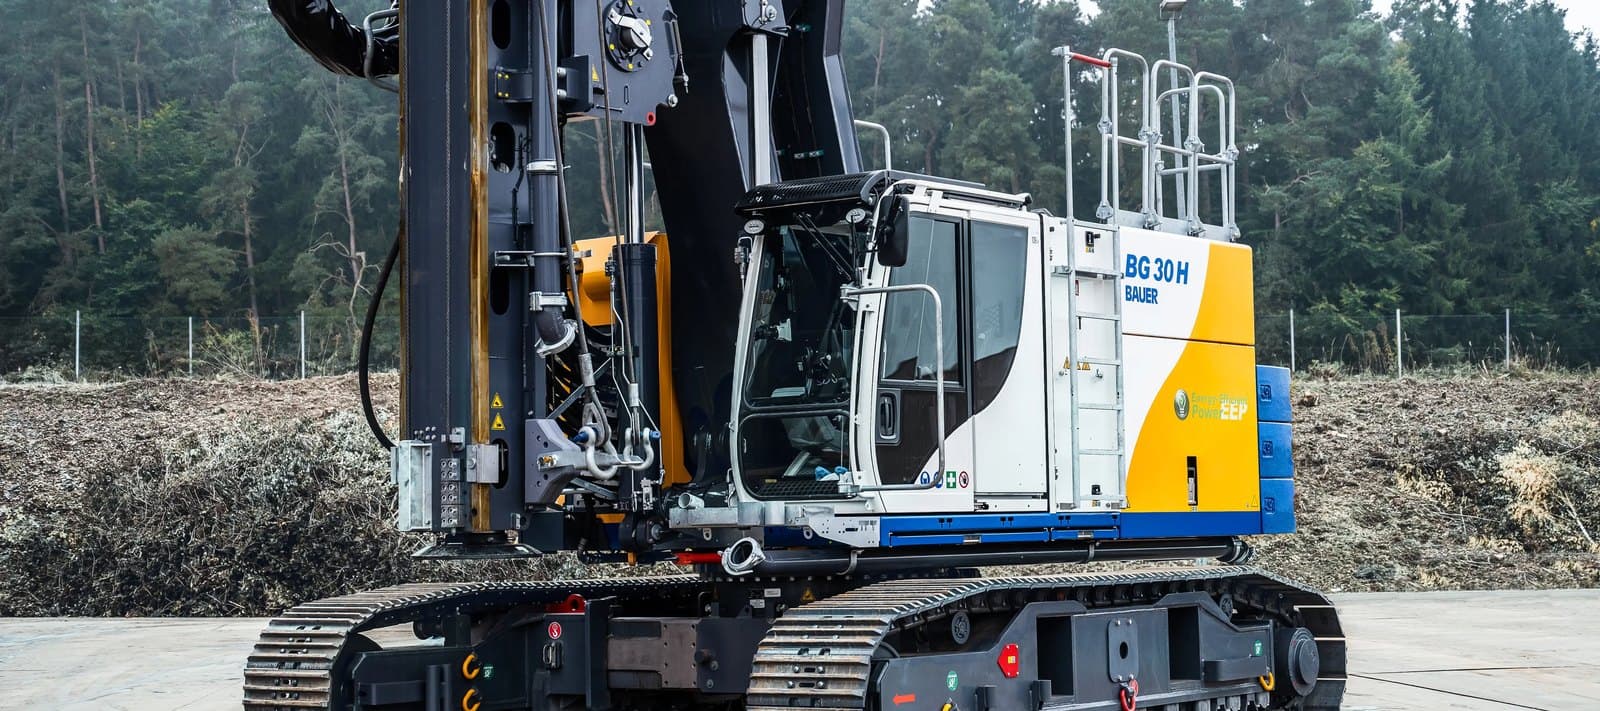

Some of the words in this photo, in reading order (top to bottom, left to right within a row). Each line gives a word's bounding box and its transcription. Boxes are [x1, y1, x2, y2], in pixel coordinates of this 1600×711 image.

[1125, 253, 1150, 280] BG
[1153, 257, 1174, 283] 30
[1176, 260, 1189, 285] H
[1125, 285, 1158, 305] BAUER
[1191, 404, 1222, 420] Power
[1220, 402, 1248, 421] EEP
